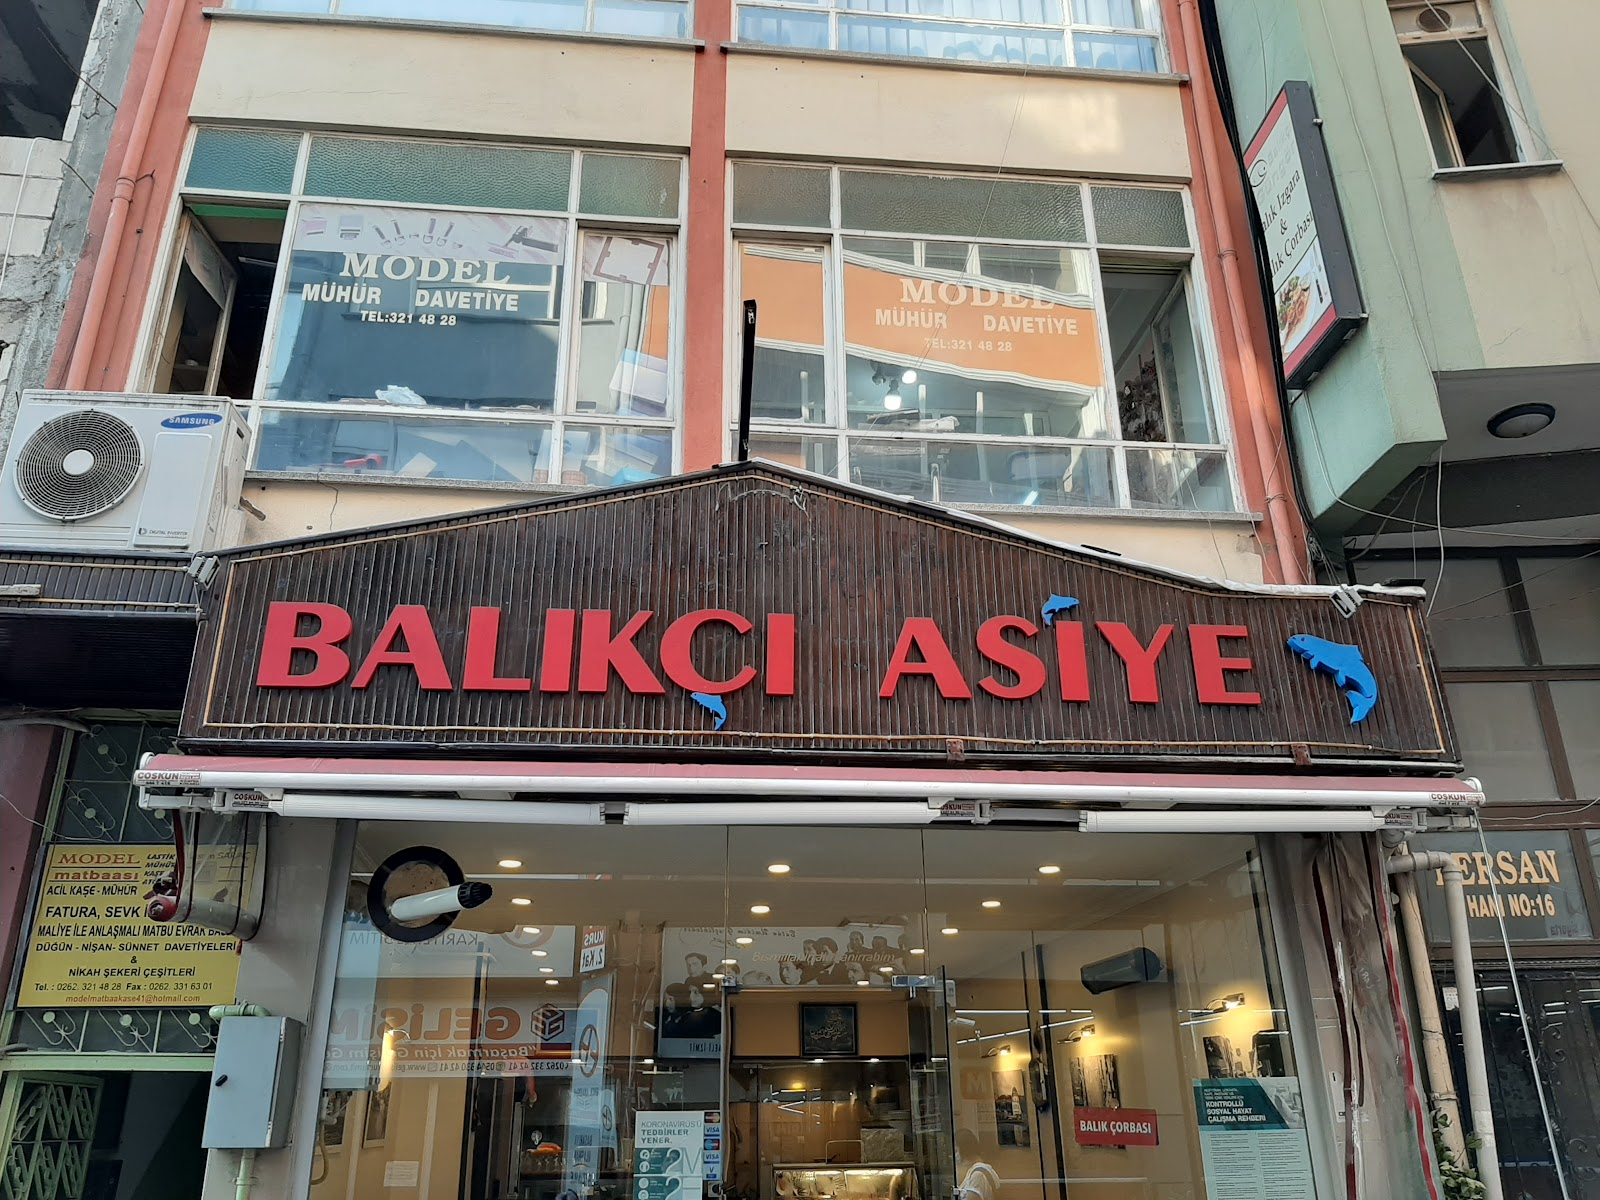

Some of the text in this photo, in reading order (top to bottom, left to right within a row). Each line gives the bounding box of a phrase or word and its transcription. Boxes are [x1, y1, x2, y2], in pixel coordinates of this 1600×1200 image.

[1280, 218, 1288, 235] &
[339, 252, 511, 285] MODEL
[301, 281, 519, 313] MÜHÜR DAVETİYE
[900, 278, 1056, 311] MODEL
[360, 309, 457, 327] TEL:321 48 28
[875, 308, 1079, 336] MÜHÜR DAVETİYE
[977, 340, 993, 352] 48
[997, 341, 1013, 353] 28
[168, 416, 215, 426] SAMSUNG
[57, 853, 141, 865] MODEL
[1436, 849, 1561, 886] ERSAN
[54, 870, 139, 880] matbaası
[46, 884, 67, 896] ACİL
[69, 886, 96, 898] KAŞE
[102, 884, 138, 896] MÜHÜR
[1507, 893, 1556, 917] NO:16
[45, 906, 101, 919] FATURA,
[104, 906, 141, 918] SEVK
[37, 923, 72, 937] MALİYE
[72, 923, 88, 937] İLE
[88, 925, 141, 939] ANLAŞMALI
[142, 925, 174, 937] MATBU
[36, 942, 73, 952] DÜĞÜN
[118, 942, 159, 952] SÜNNET
[164, 941, 237, 951] DAVETİYELERİ
[130, 955, 138, 964] &
[68, 967, 196, 979] NİKAH ŞEKERİ ÇEŞİTLERİ
[82, 983, 96, 991] 321
[99, 983, 109, 991] 48
[111, 983, 122, 991] 28
[126, 983, 141, 991] Fax
[173, 983, 188, 991] 331
[190, 983, 200, 991] 63
[202, 983, 213, 991] 01
[1080, 1120, 1151, 1135] BALIK ÇORBASI
